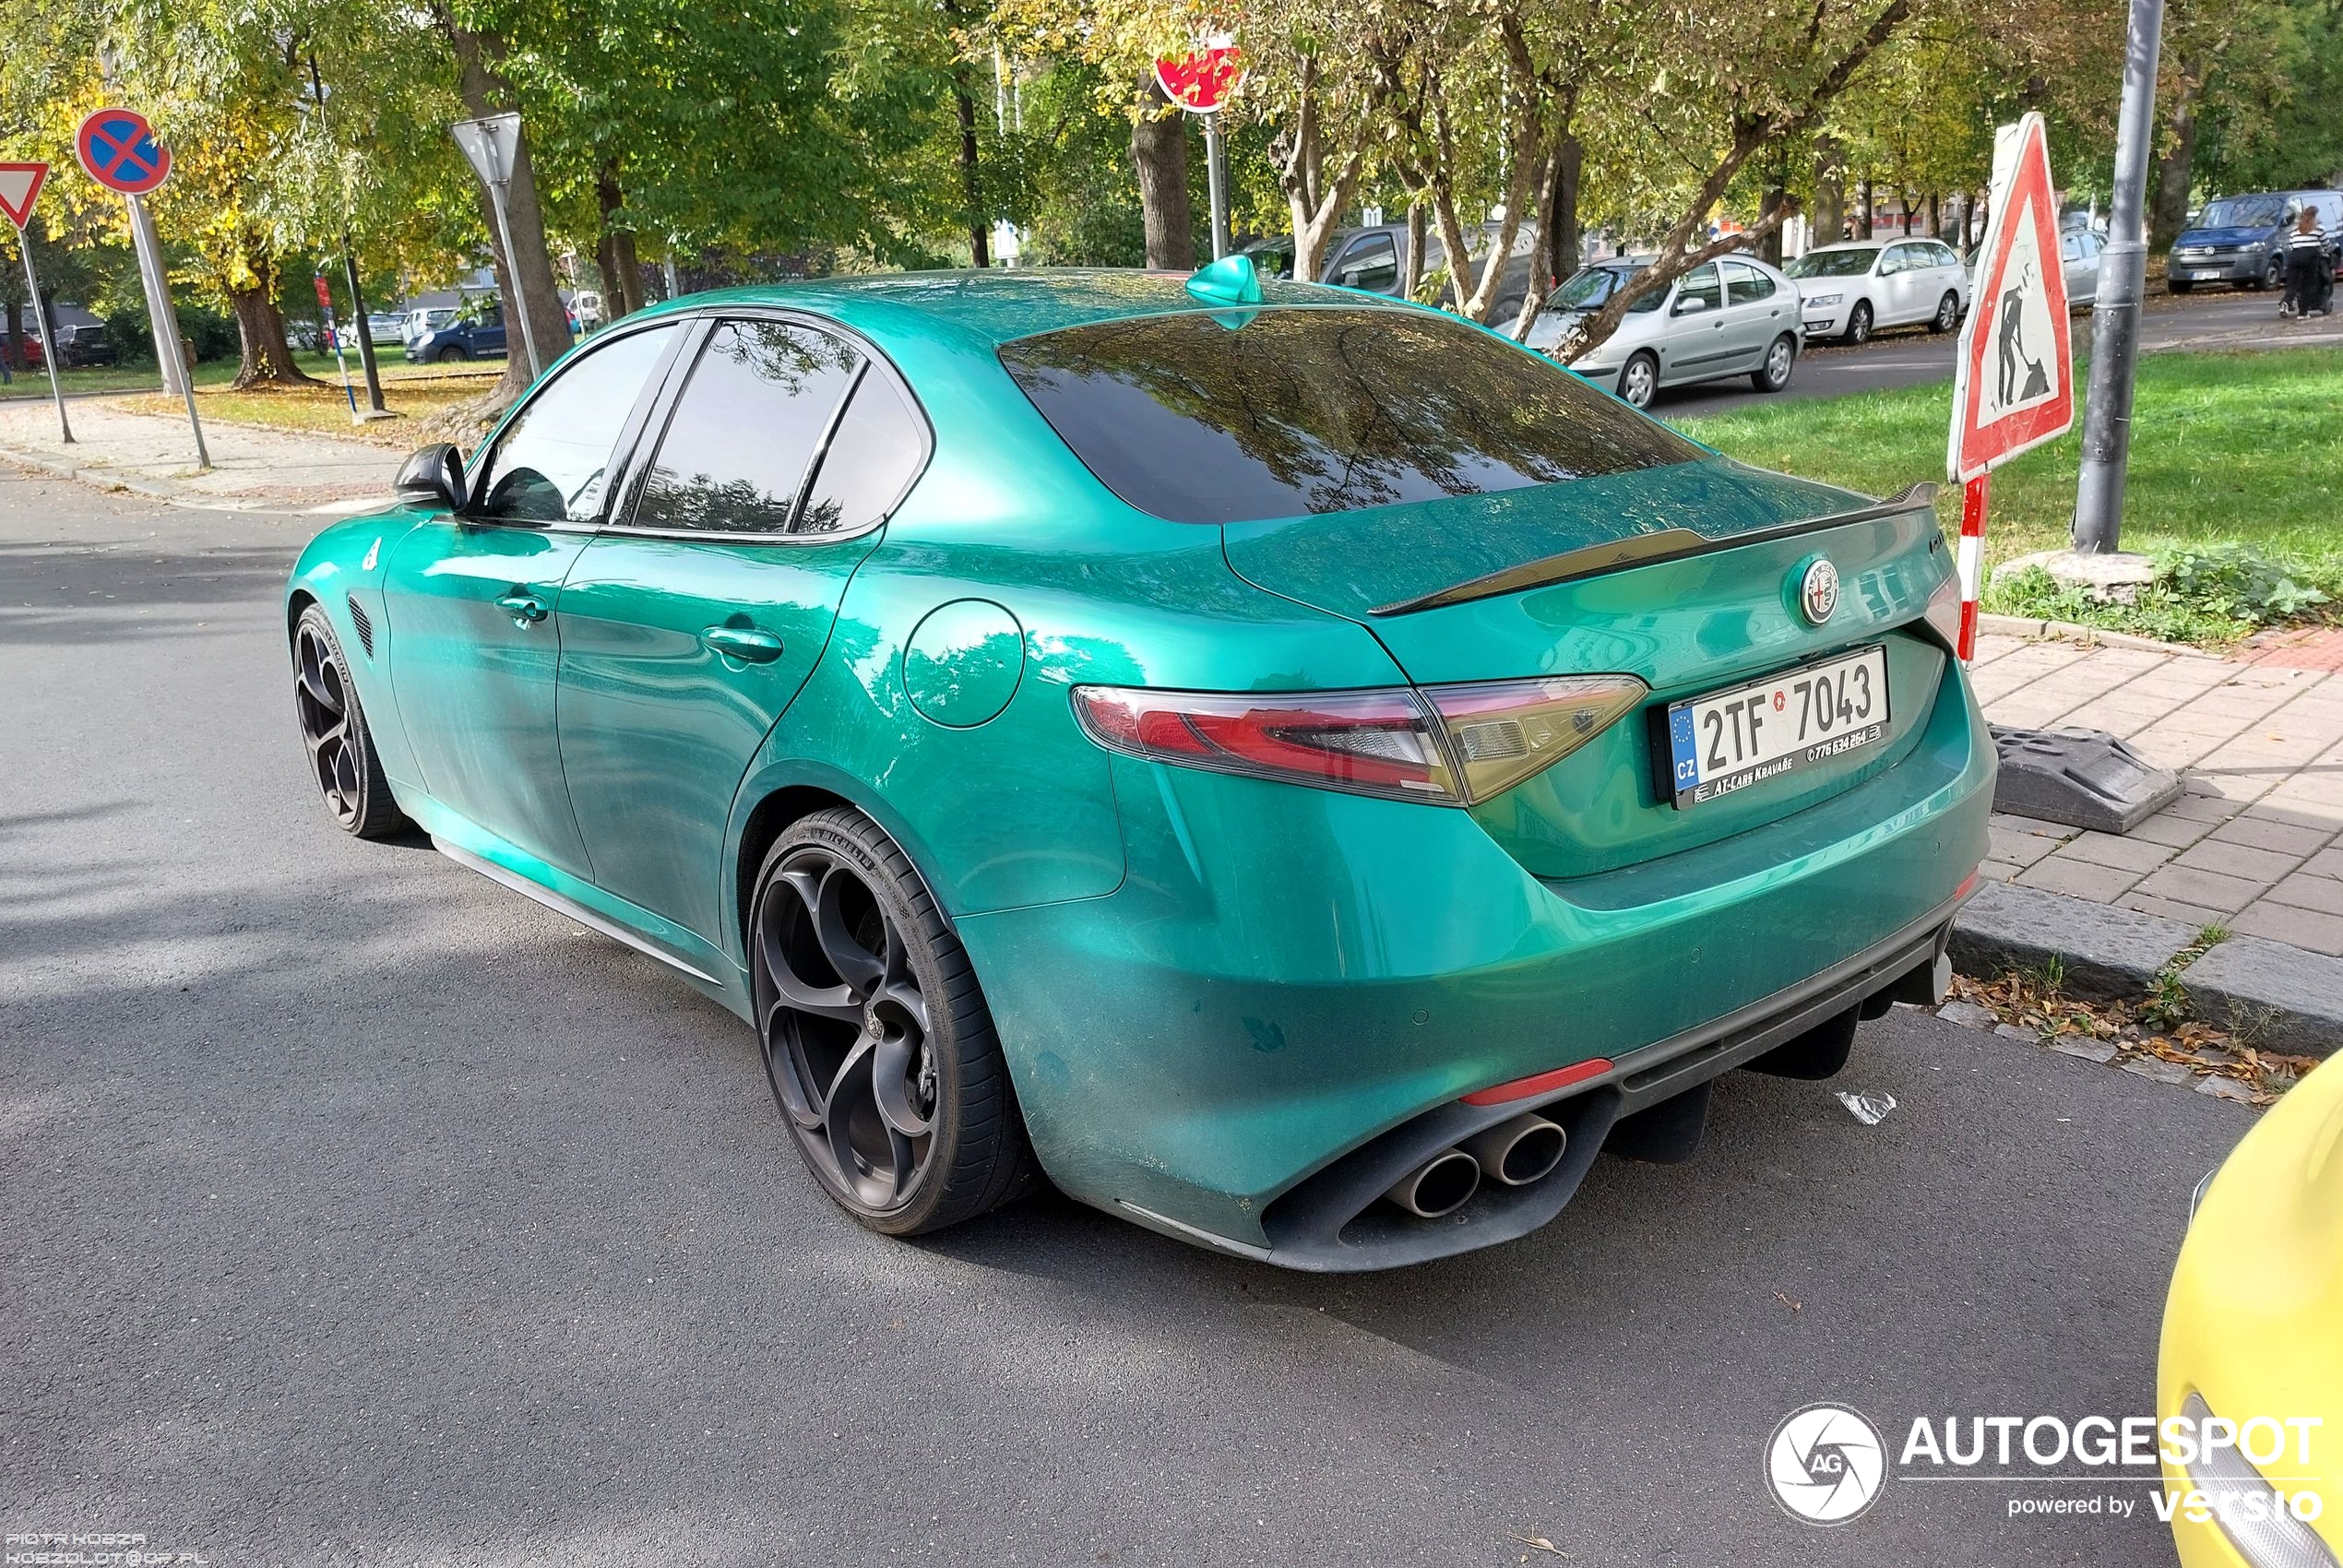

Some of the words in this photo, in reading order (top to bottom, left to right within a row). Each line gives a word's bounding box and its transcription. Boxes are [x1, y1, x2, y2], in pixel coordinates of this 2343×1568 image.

[1704, 694, 1766, 771] 2TF
[1794, 664, 1871, 742] 7043
[1833, 736, 1849, 754] 634
[1850, 731, 1866, 747] 264
[1677, 758, 1695, 780] CZ
[822, 829, 874, 869] MICHELIN
